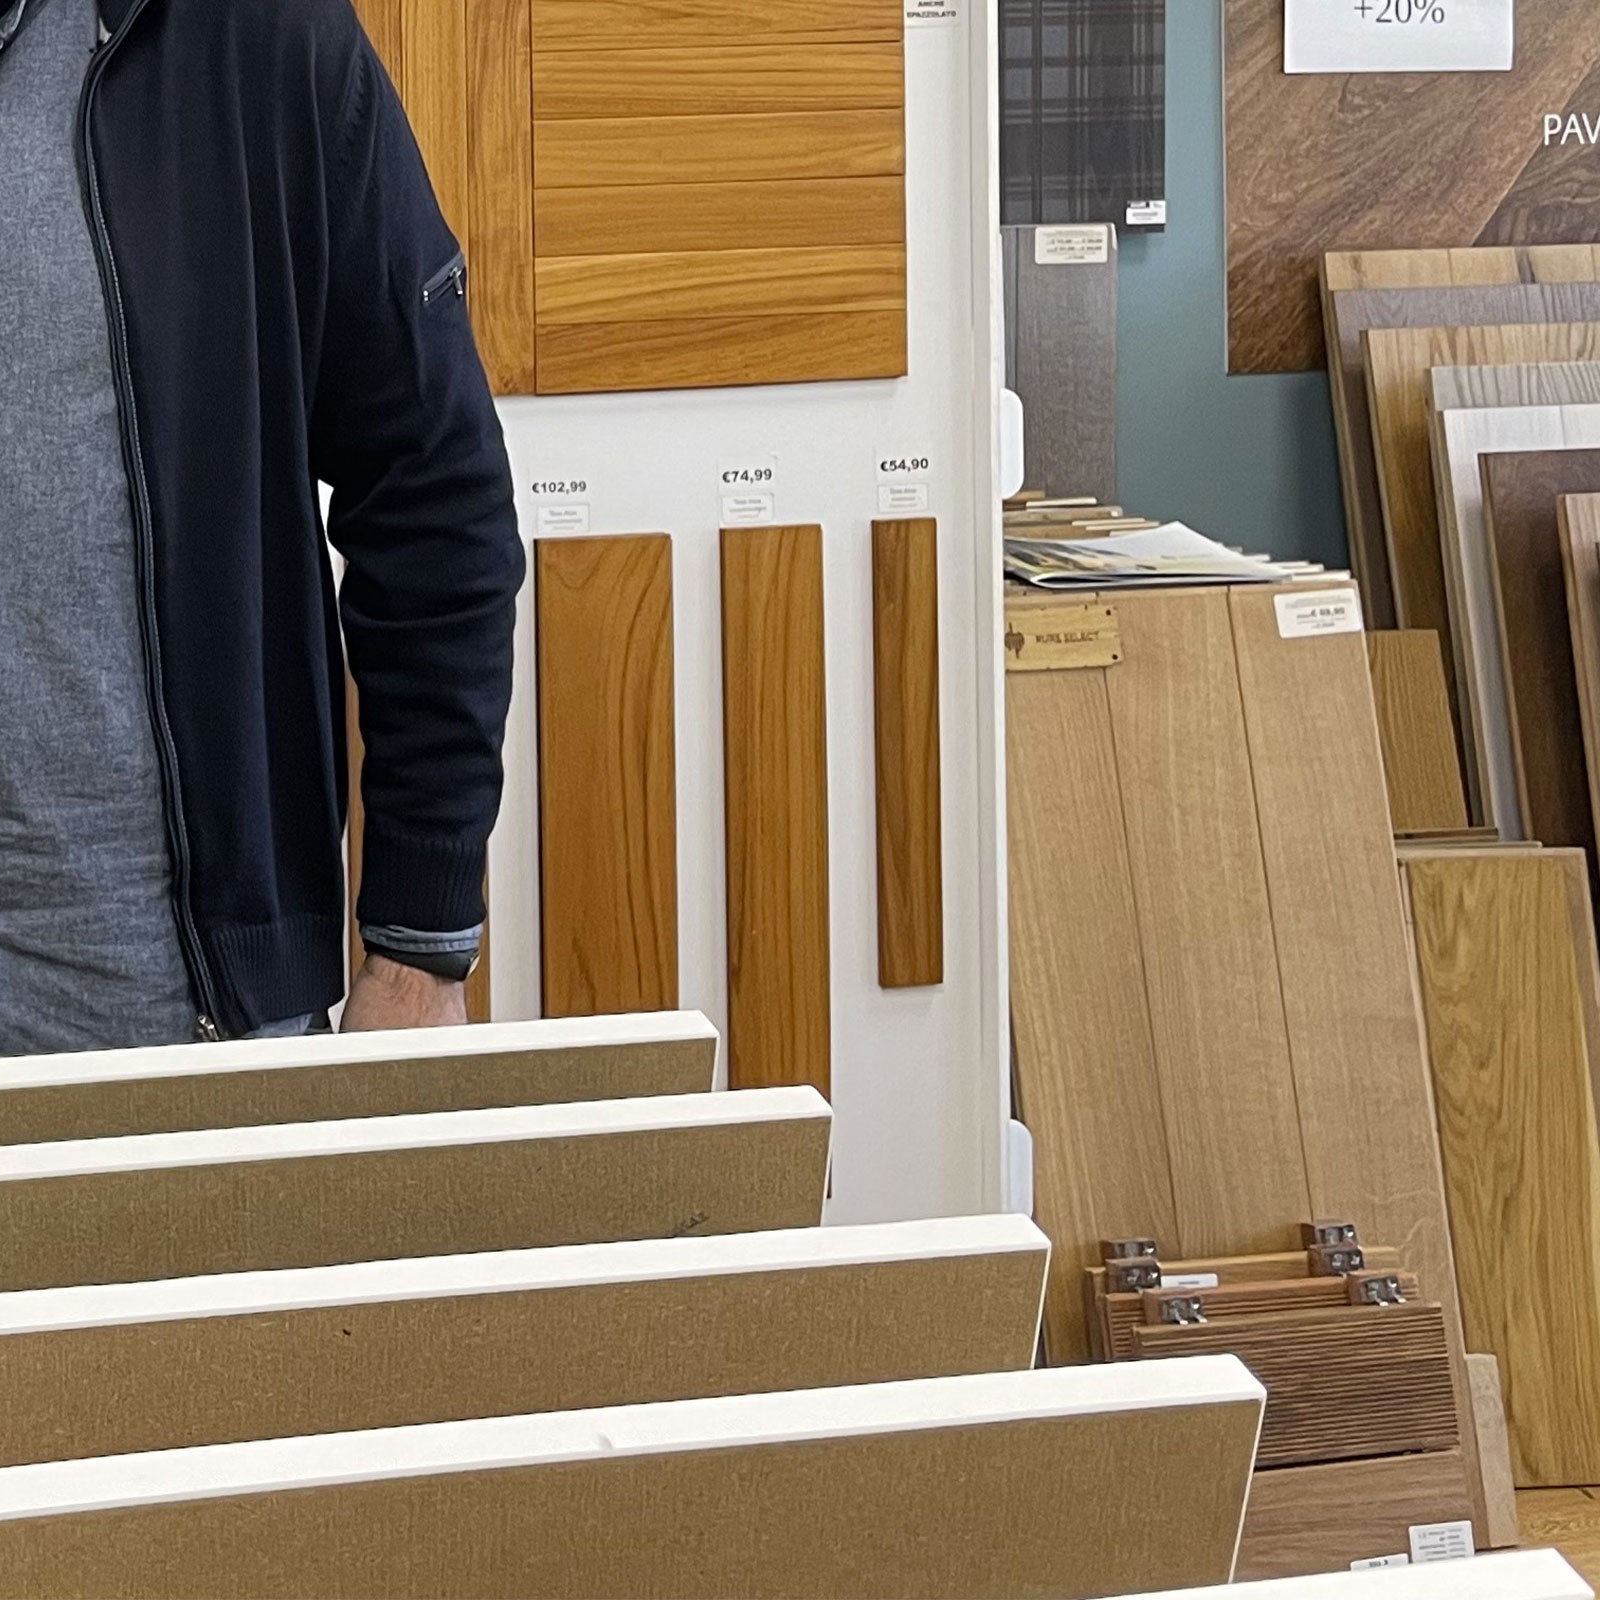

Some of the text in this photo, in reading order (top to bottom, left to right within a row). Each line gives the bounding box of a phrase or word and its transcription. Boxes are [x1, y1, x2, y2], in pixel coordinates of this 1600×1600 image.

[1544, 113, 1600, 146] PAV
[880, 458, 929, 472] €54,90
[722, 468, 773, 484] €74,99
[531, 481, 587, 495] €102,99
